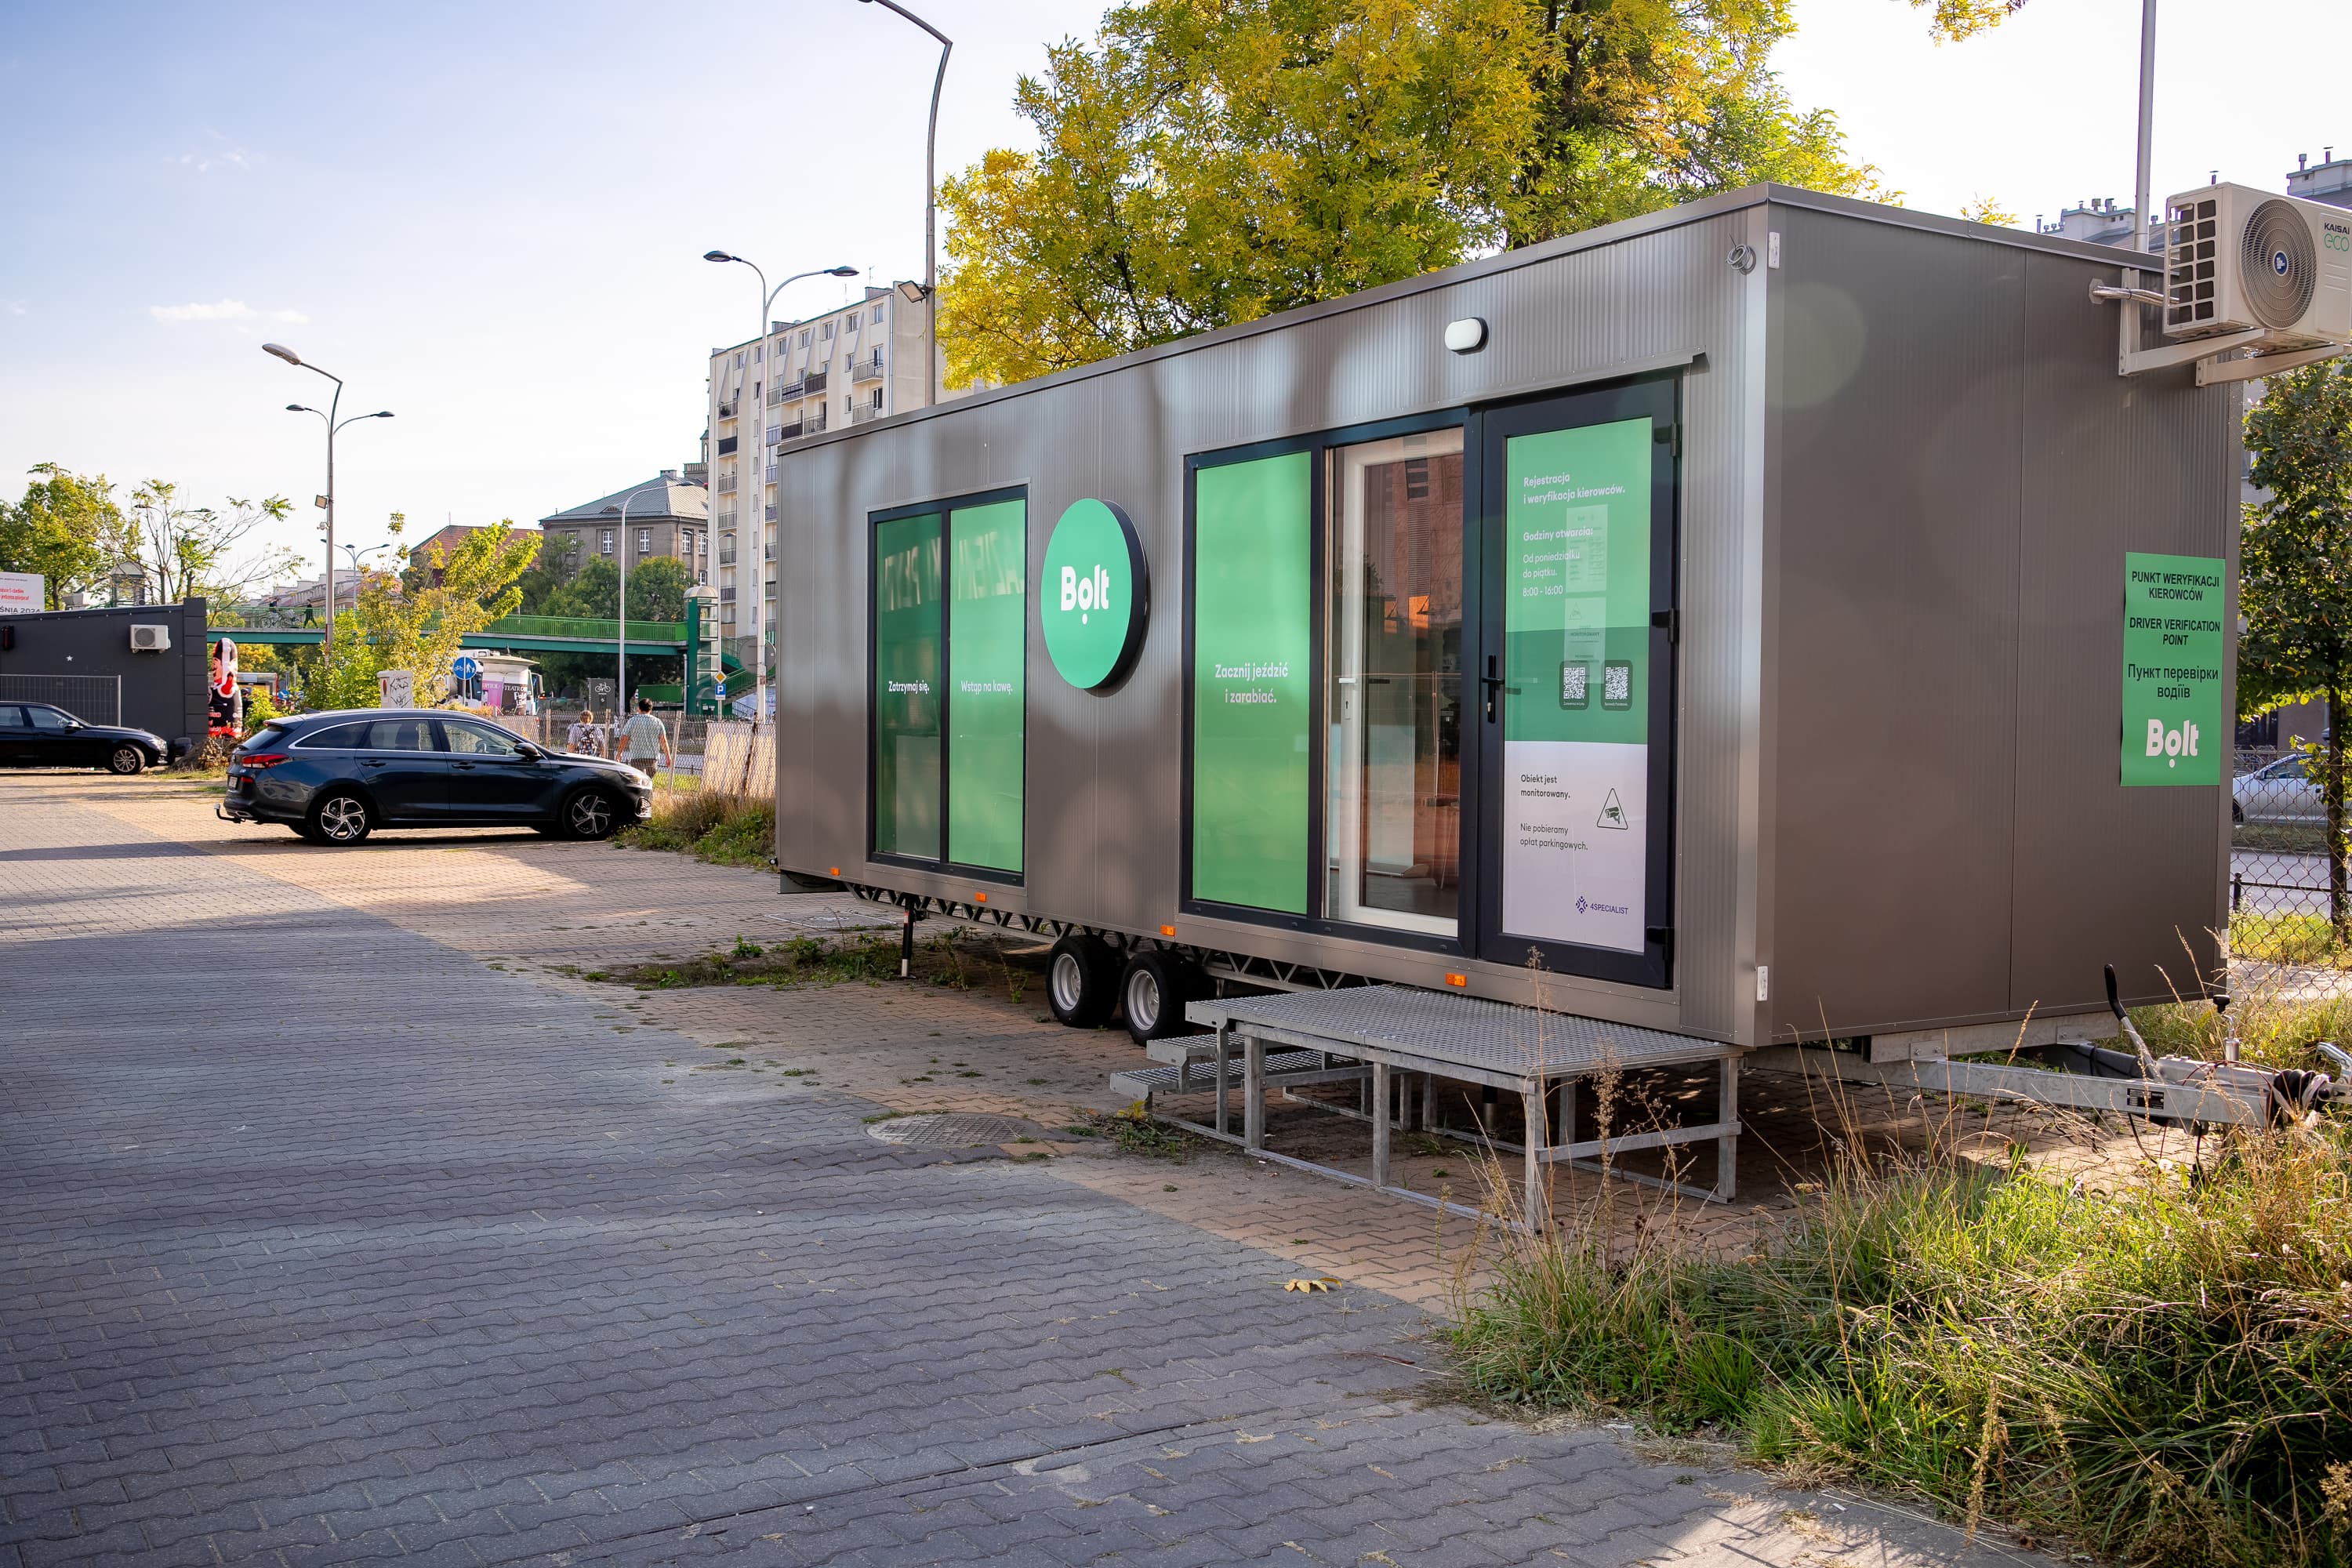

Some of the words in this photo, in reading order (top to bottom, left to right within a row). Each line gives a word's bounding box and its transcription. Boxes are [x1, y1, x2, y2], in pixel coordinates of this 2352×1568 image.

[2324, 222, 2350, 234] KAISAI
[2324, 233, 2350, 252] eco
[1523, 472, 1570, 488] Rejestracja
[1523, 494, 1526, 504] i
[1527, 489, 1576, 505] weryfikacja
[1577, 484, 1625, 499] kierowców.
[1523, 529, 1554, 542] Godziny
[1555, 526, 1593, 539] otwarcia:
[1523, 553, 1534, 564] Od
[1523, 568, 1532, 578] do
[1533, 567, 1558, 579] piątku.
[2131, 571, 2161, 584] PUNKT
[2162, 572, 2220, 587] WERYFIKACJI
[1061, 564, 1109, 625] Bolt
[1523, 586, 1538, 597] 8:00
[1544, 585, 1563, 596] 16:00
[2148, 586, 2203, 601] KIEROWCÓW
[2129, 617, 2162, 630] DRIVER
[2164, 619, 2220, 632] VERIFICATION
[2162, 633, 2188, 646] POINT
[1215, 664, 1250, 681] Zacznij
[1252, 662, 1288, 681] jeździć
[2128, 663, 2161, 681] Пункт
[2163, 666, 2219, 683] перевірки
[888, 680, 918, 695] Zatrzymaj
[919, 680, 930, 695] się.
[961, 680, 981, 695] Wstąp
[983, 683, 992, 691] na
[993, 679, 1013, 695] kawę.
[2157, 684, 2190, 700] водіїв
[1225, 688, 1228, 702] i
[1229, 688, 1277, 702] zarabiać.
[2145, 718, 2199, 768] Bolt
[1520, 774, 1544, 783] Obiekt
[1544, 775, 1558, 785] jest
[1520, 788, 1570, 800] monitorowany.
[1520, 822, 1531, 831] Nie
[1533, 824, 1569, 836] pobieramy
[1520, 837, 1538, 847] opłat
[1539, 838, 1588, 851] parkingowych.
[1590, 903, 1628, 915] 4SPECIALIST
